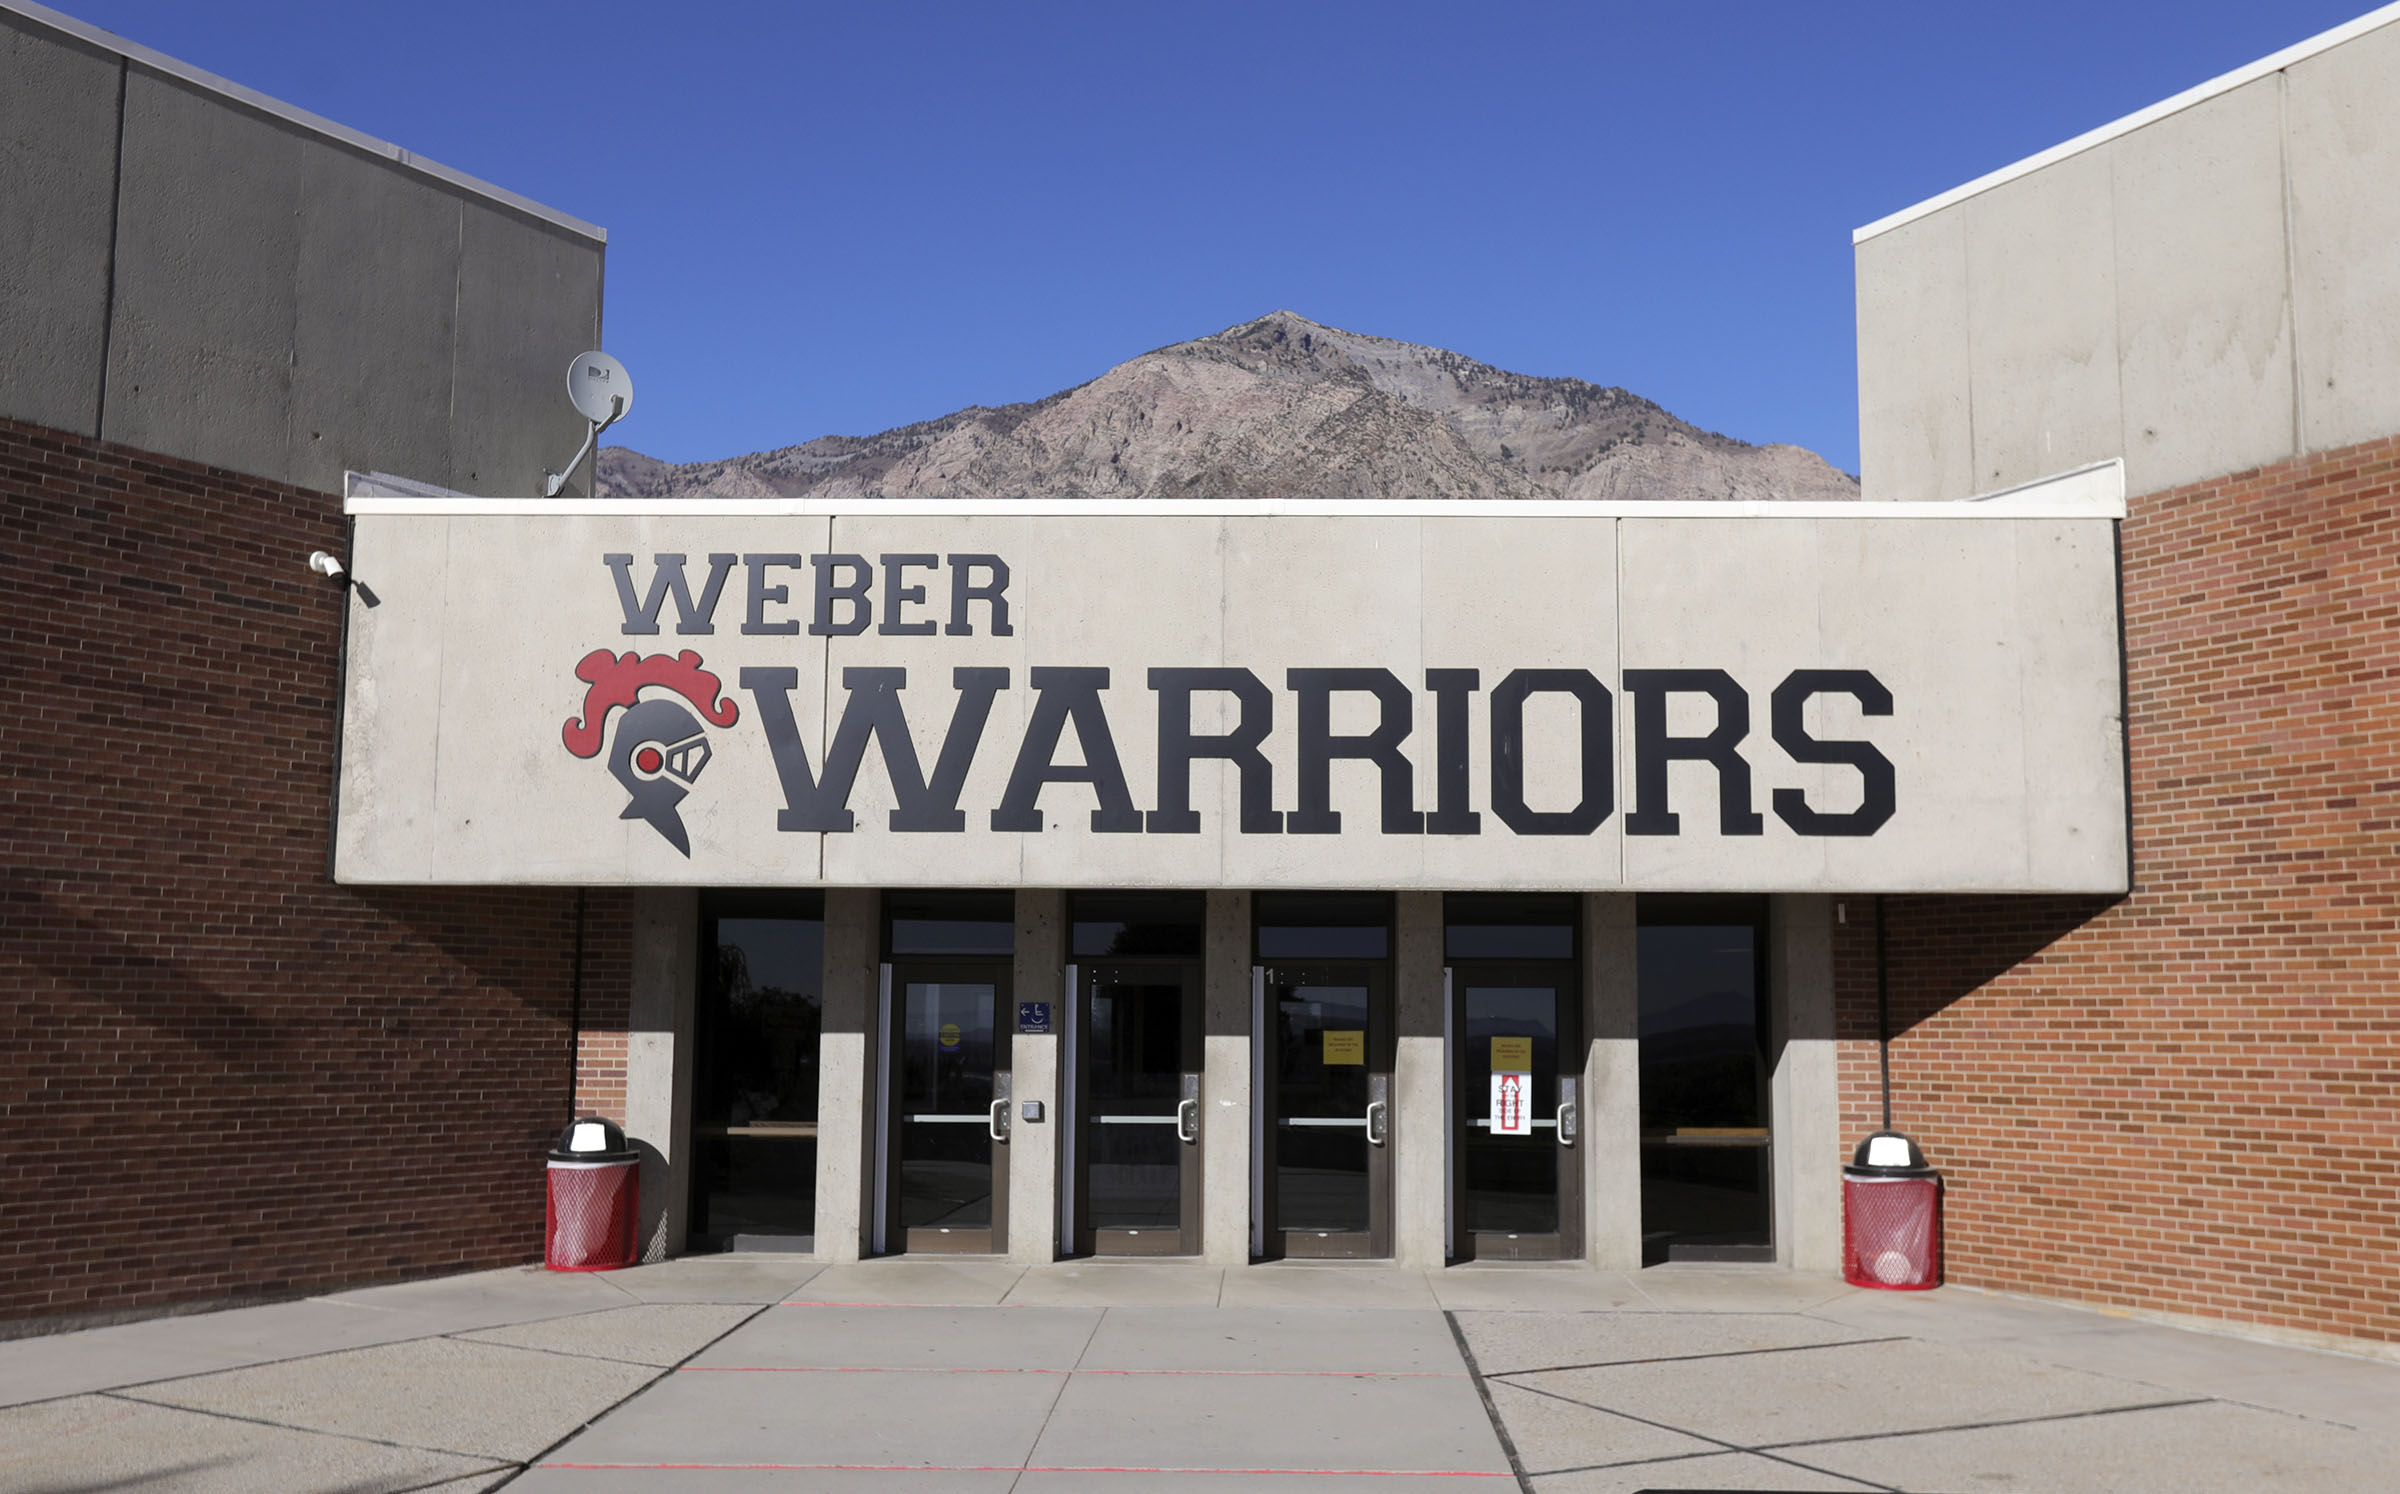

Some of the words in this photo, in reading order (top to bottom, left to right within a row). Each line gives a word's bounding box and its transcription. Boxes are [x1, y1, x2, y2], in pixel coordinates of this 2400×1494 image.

[603, 553, 1014, 637] WEBER
[739, 667, 1896, 837] WARRIORS
[1265, 967, 1274, 984] 1
[1498, 1085, 1523, 1093] STAY
[1495, 1099, 1524, 1107] RIGHT
